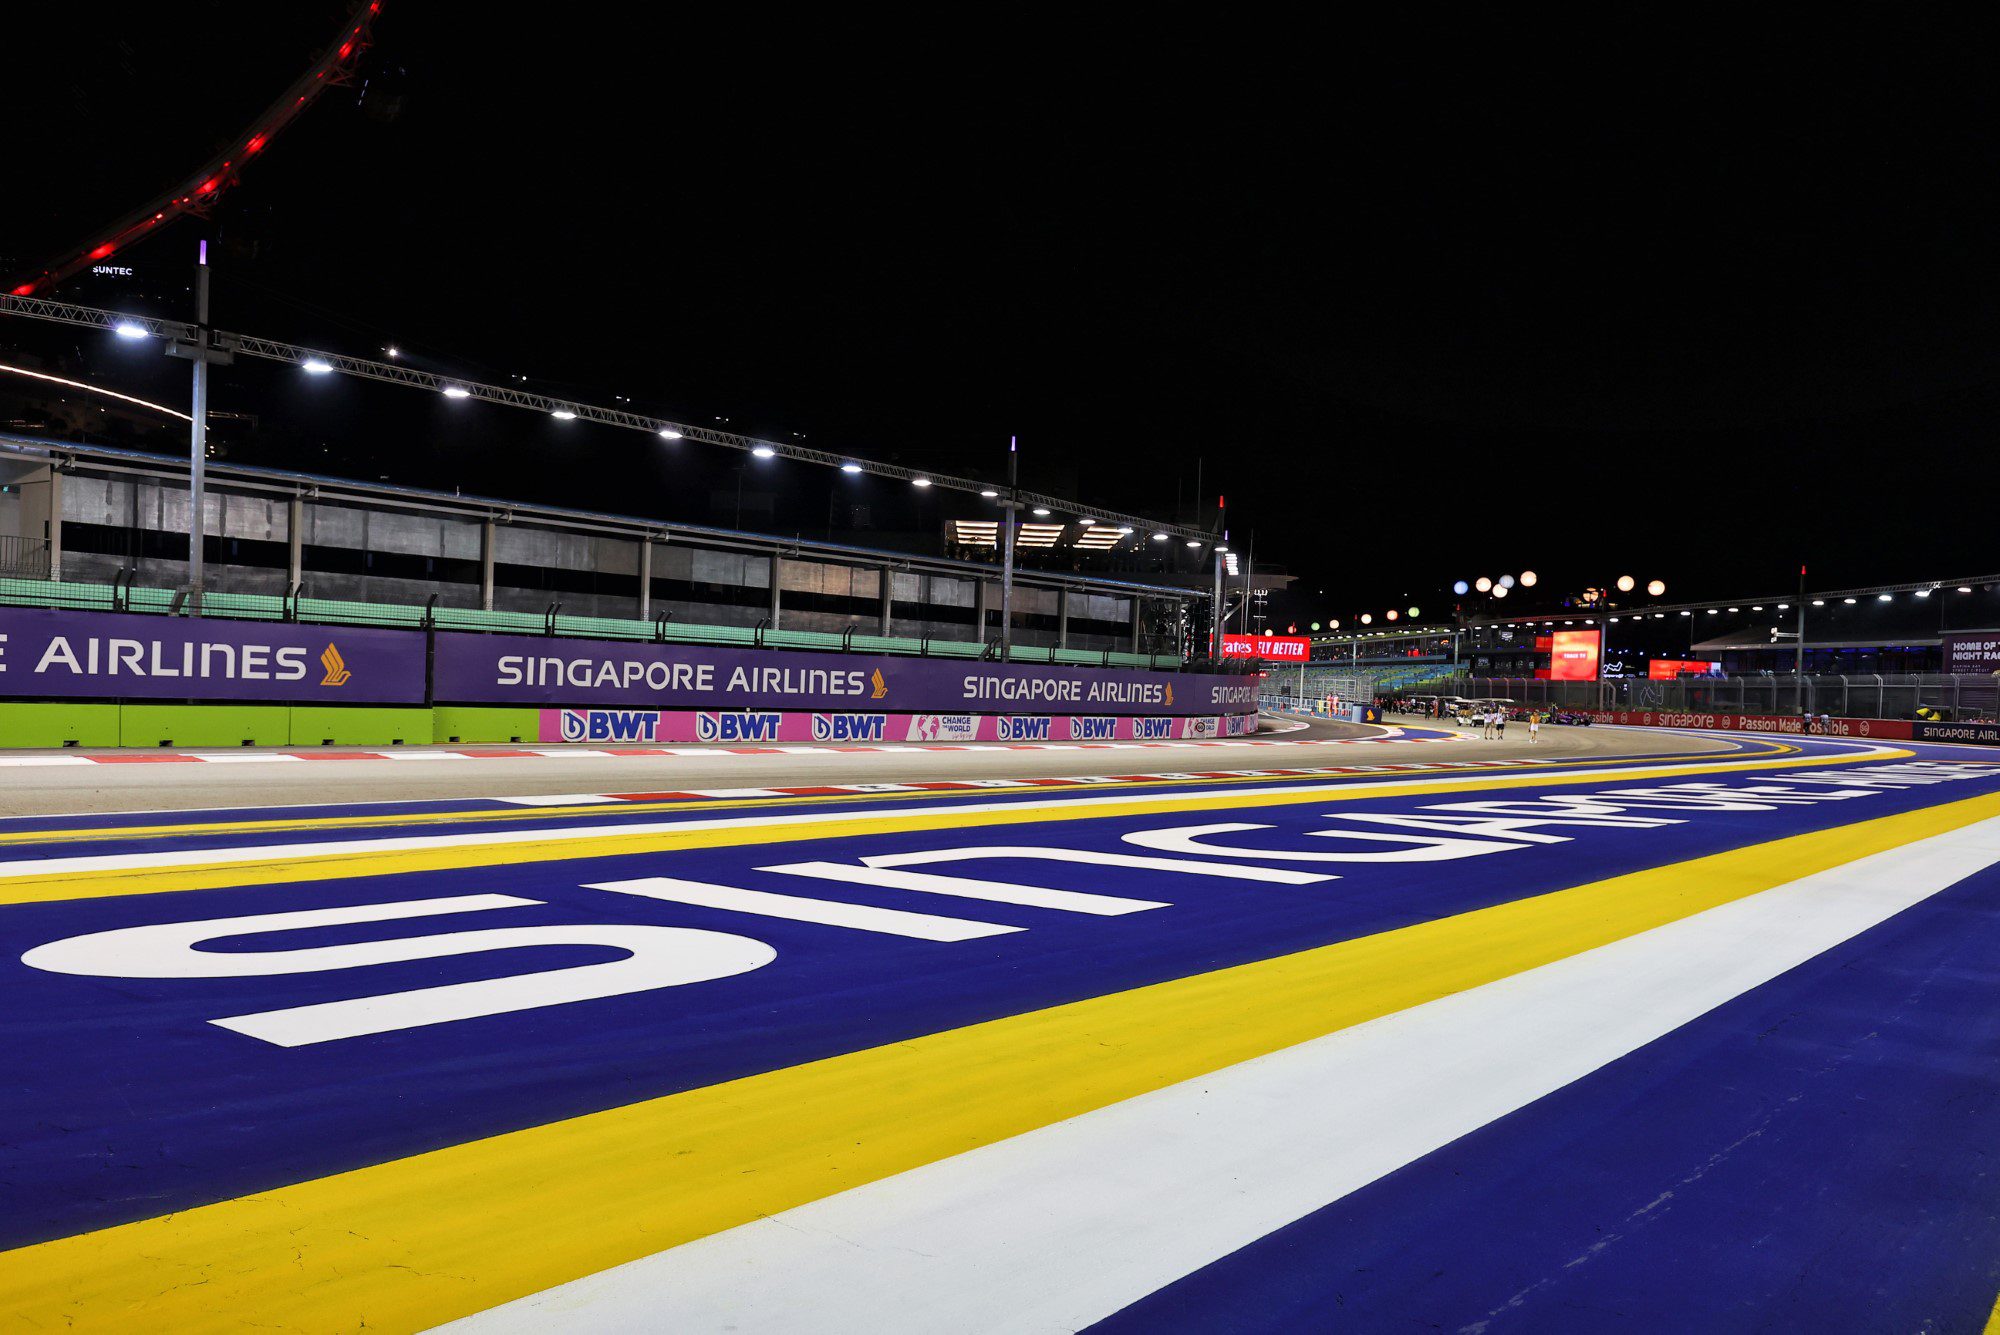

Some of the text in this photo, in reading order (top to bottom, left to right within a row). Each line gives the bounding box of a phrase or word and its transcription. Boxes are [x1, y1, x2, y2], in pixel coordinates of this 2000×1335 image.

[93, 266, 132, 276] SUNTEC
[1273, 642, 1304, 656] BETTER
[1952, 651, 1982, 660] NIGHT
[1953, 642, 1982, 651] HOME
[1983, 641, 1997, 650] OF
[34, 636, 307, 680] AIRLINES
[497, 656, 865, 696] SINGAPORE AIRLINES
[963, 676, 1163, 703] SINGAPORE AIRLINES
[588, 711, 659, 739] BWT
[720, 713, 781, 739] BWT
[833, 715, 885, 739] BWT
[942, 716, 971, 725] CHANGE
[948, 725, 971, 733] WORLD
[1012, 717, 1050, 739] BWT
[1083, 718, 1116, 738] BWT
[1144, 718, 1172, 737] BWT
[1739, 717, 1776, 731] Passion
[1778, 718, 1802, 733] Made
[1923, 727, 1975, 740] SINGAPORE
[21, 782, 1883, 1047] SINGAPORE
